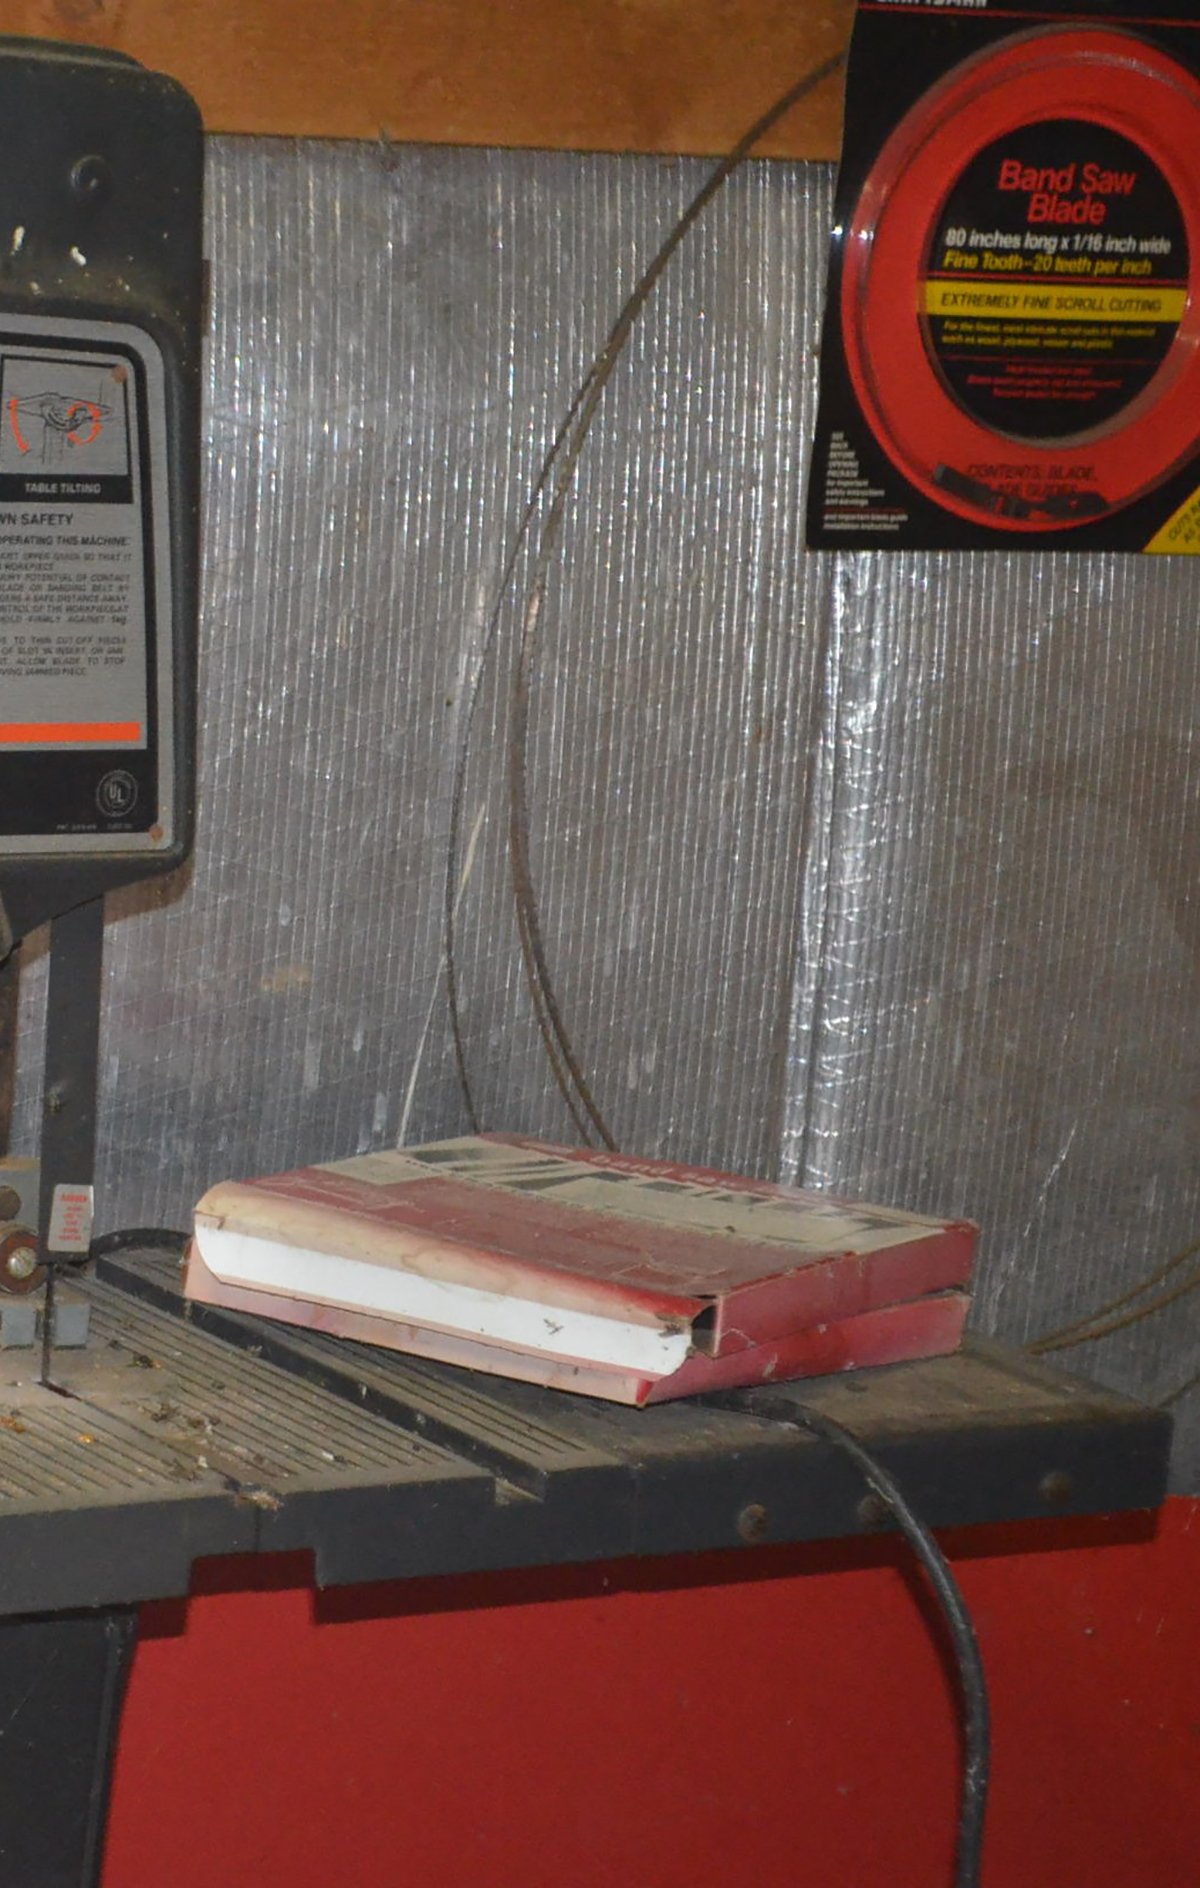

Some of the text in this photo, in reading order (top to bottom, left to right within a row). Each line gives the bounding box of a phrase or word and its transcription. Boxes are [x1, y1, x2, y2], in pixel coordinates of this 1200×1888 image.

[997, 159, 1137, 196] Band Saw
[1027, 193, 1108, 225] Blade
[945, 227, 1172, 254] 80 inches long x 1/16 inch wide
[943, 248, 979, 269] Fine
[1054, 255, 1092, 273] teeth
[1094, 259, 1119, 278] per
[1122, 257, 1153, 275] inch
[941, 292, 1162, 314] EXTREMELY FINE SCROLL CUTTING
[24, 482, 102, 494] TABLE TILTING
[21, 512, 74, 527] SAFETY
[56, 536, 79, 546] THIS
